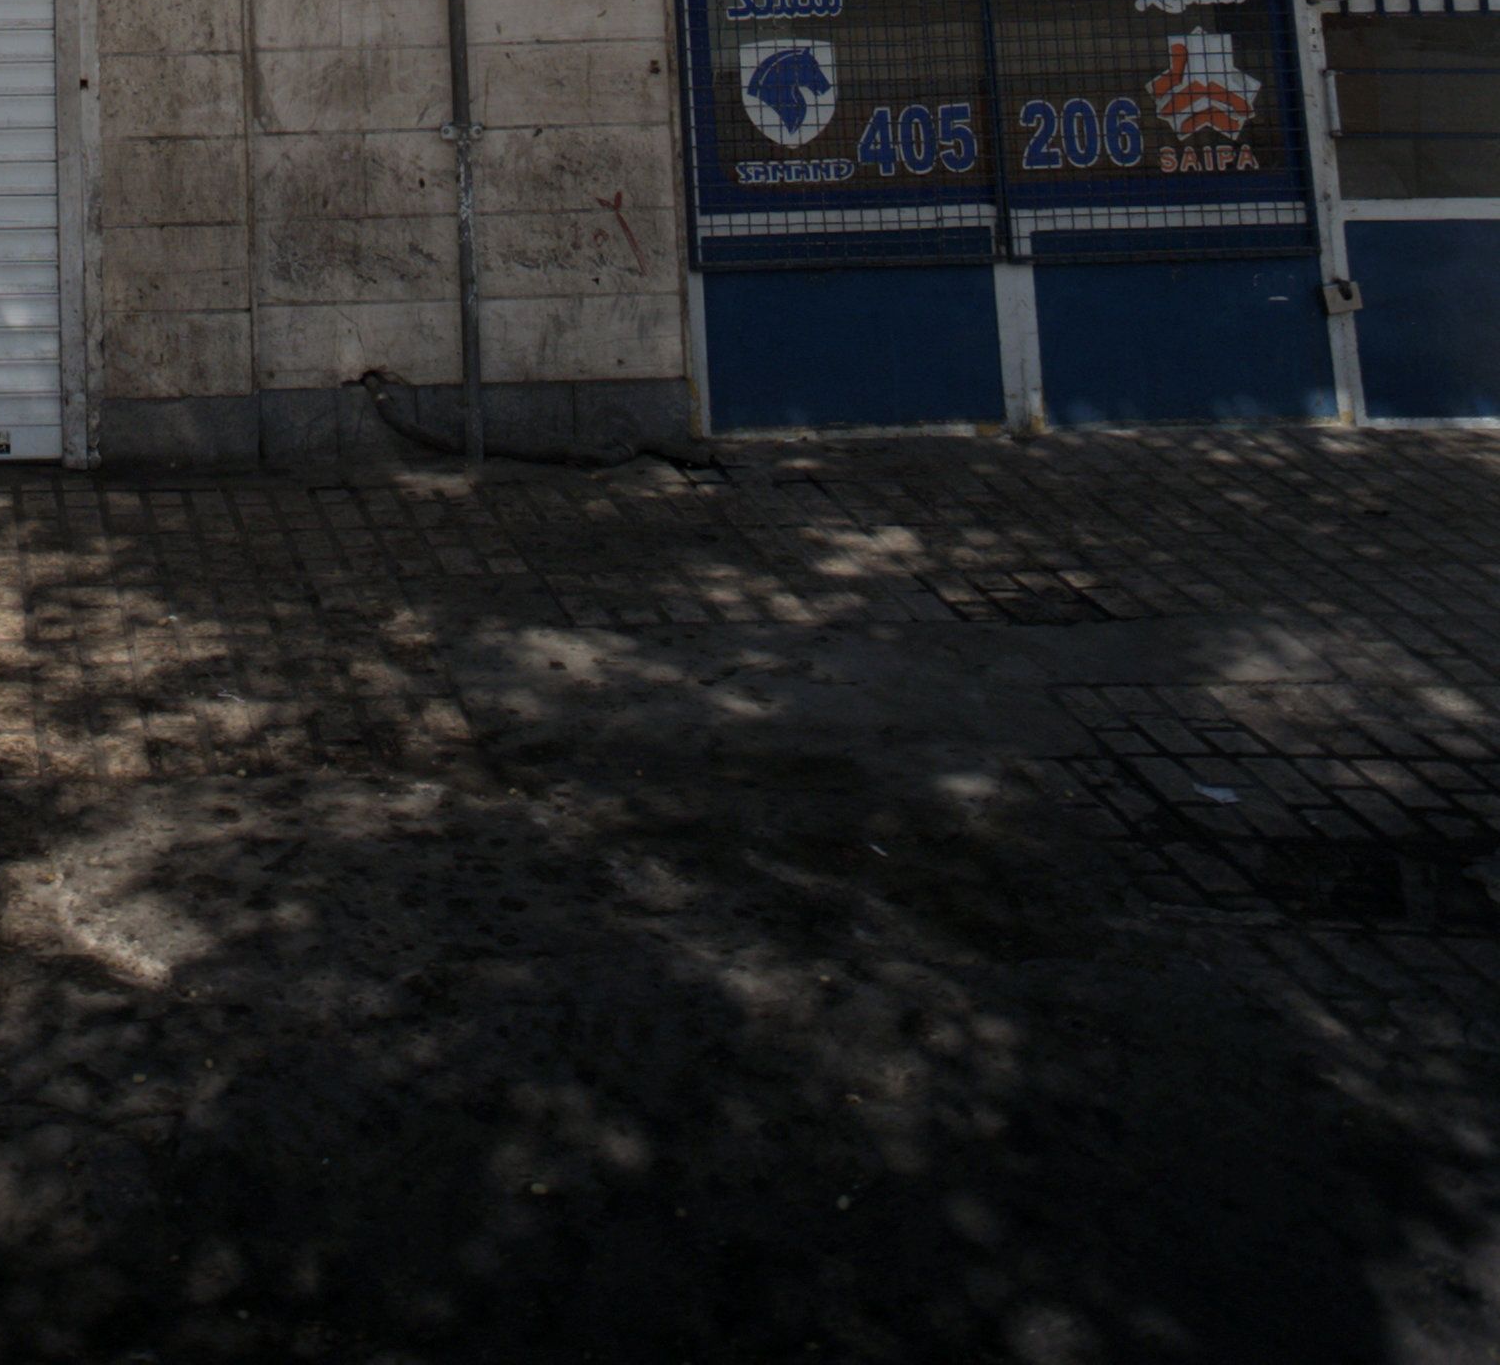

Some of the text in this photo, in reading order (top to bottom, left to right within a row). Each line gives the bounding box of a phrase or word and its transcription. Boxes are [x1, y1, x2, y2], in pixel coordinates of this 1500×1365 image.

[857, 102, 978, 176] 405
[1020, 97, 1144, 170] 206
[1160, 144, 1260, 172] SAIPA
[735, 158, 855, 184] SAMAND
